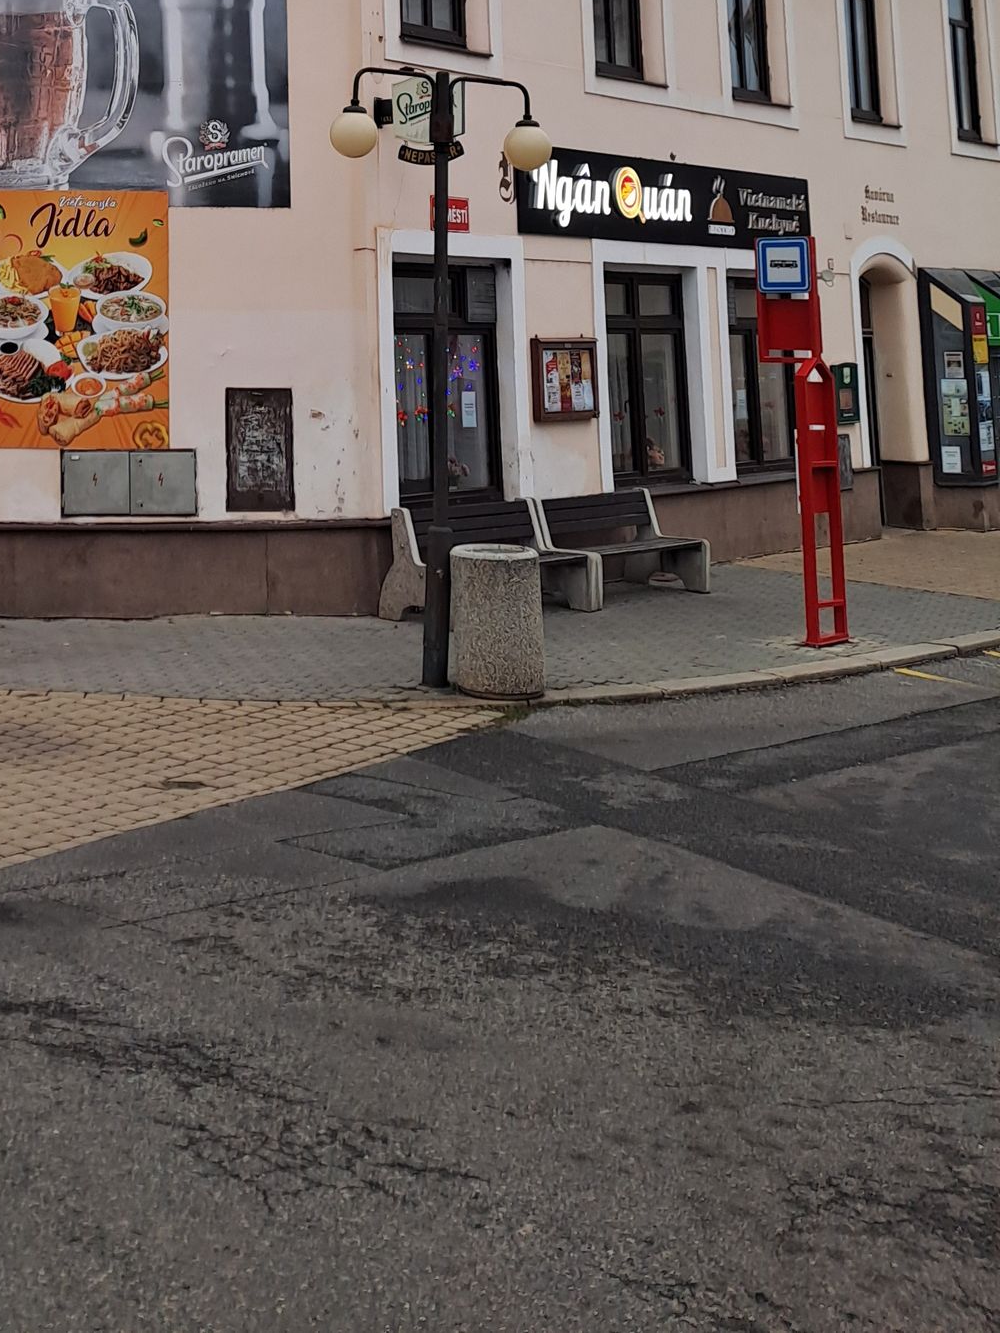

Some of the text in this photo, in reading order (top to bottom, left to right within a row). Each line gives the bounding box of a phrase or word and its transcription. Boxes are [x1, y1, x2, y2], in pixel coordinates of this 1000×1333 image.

[396, 92, 432, 125] Starop
[162, 136, 268, 188] Staropramen
[531, 158, 612, 228] Ngân
[612, 166, 693, 225] Quán
[30, 202, 116, 249] Jídla
